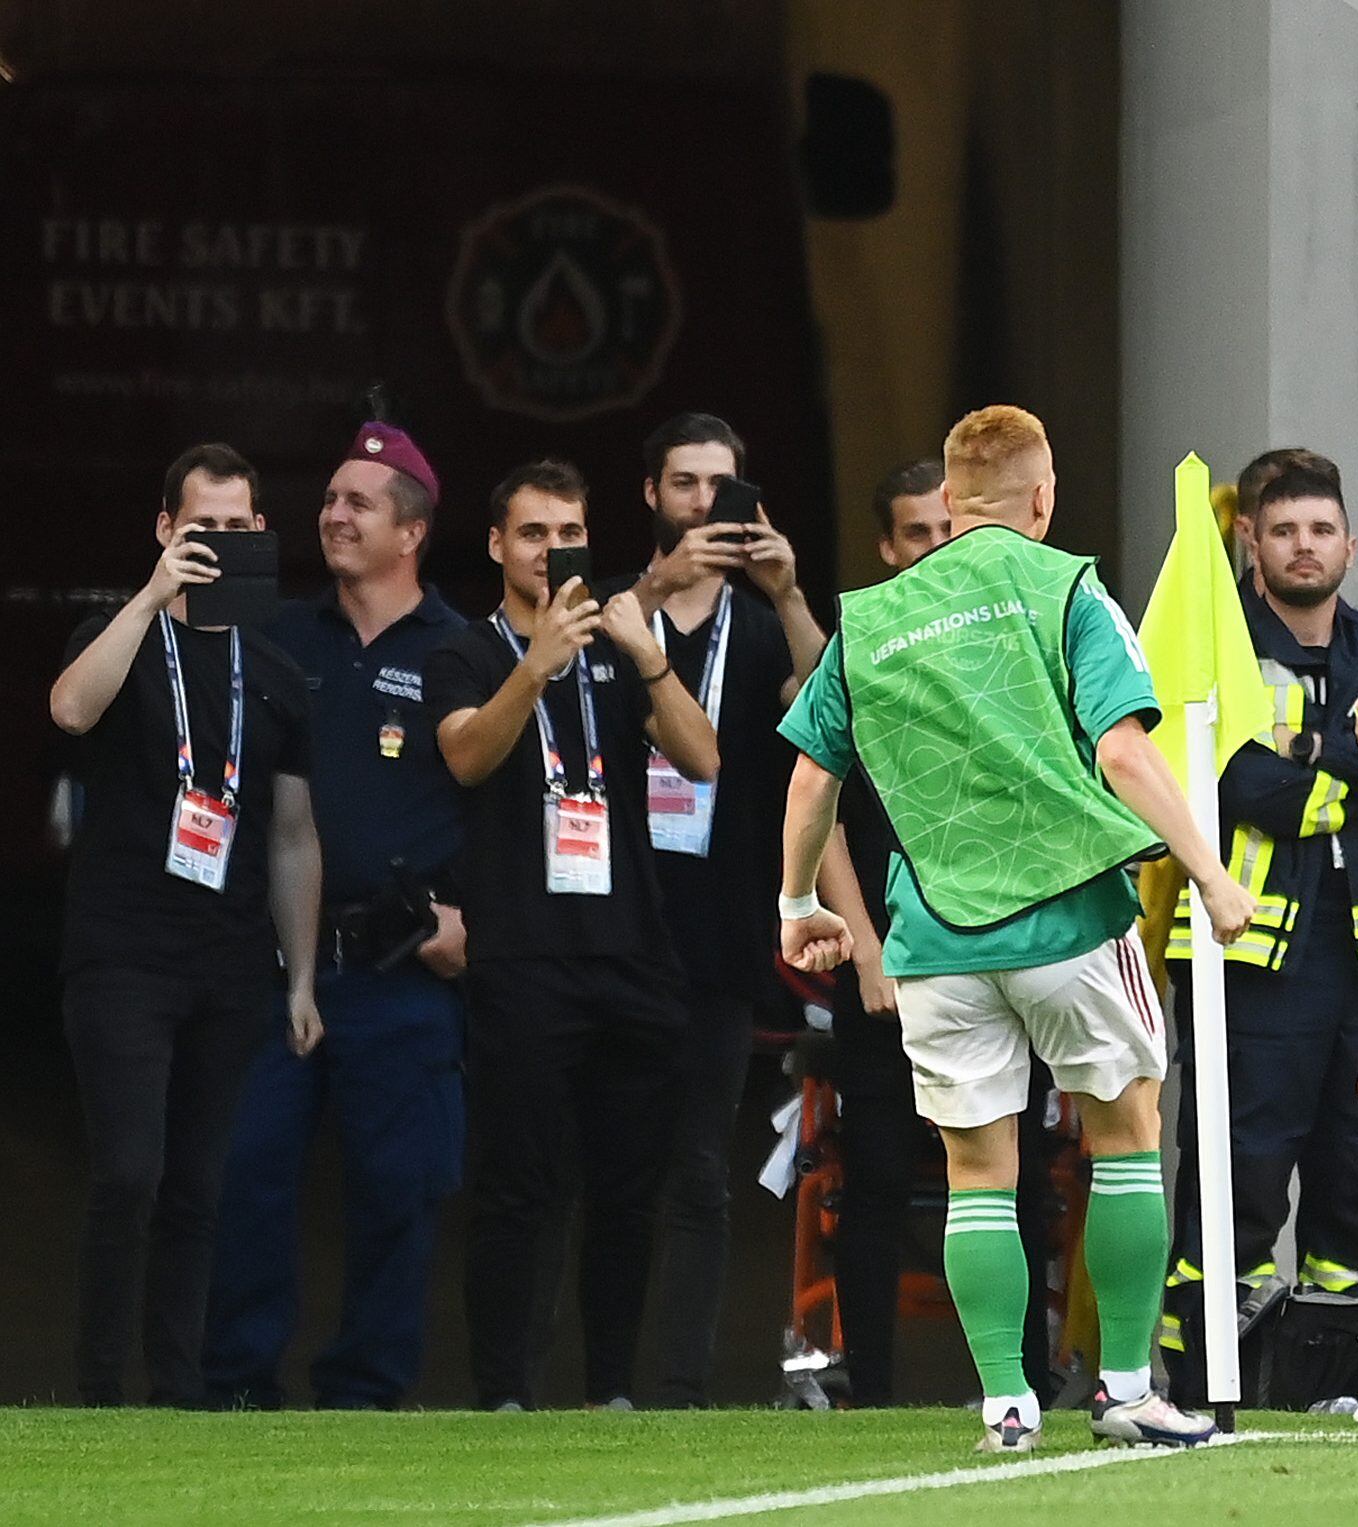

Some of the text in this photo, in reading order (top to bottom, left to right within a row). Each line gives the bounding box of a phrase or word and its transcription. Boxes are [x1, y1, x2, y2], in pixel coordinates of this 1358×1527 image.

[42, 219, 366, 270] FIRE SAFETY
[50, 281, 369, 335] EVENTS KFT.
[870, 638, 908, 665] UEFA
[908, 606, 991, 646] NATIONS
[191, 813, 213, 830] NL7
